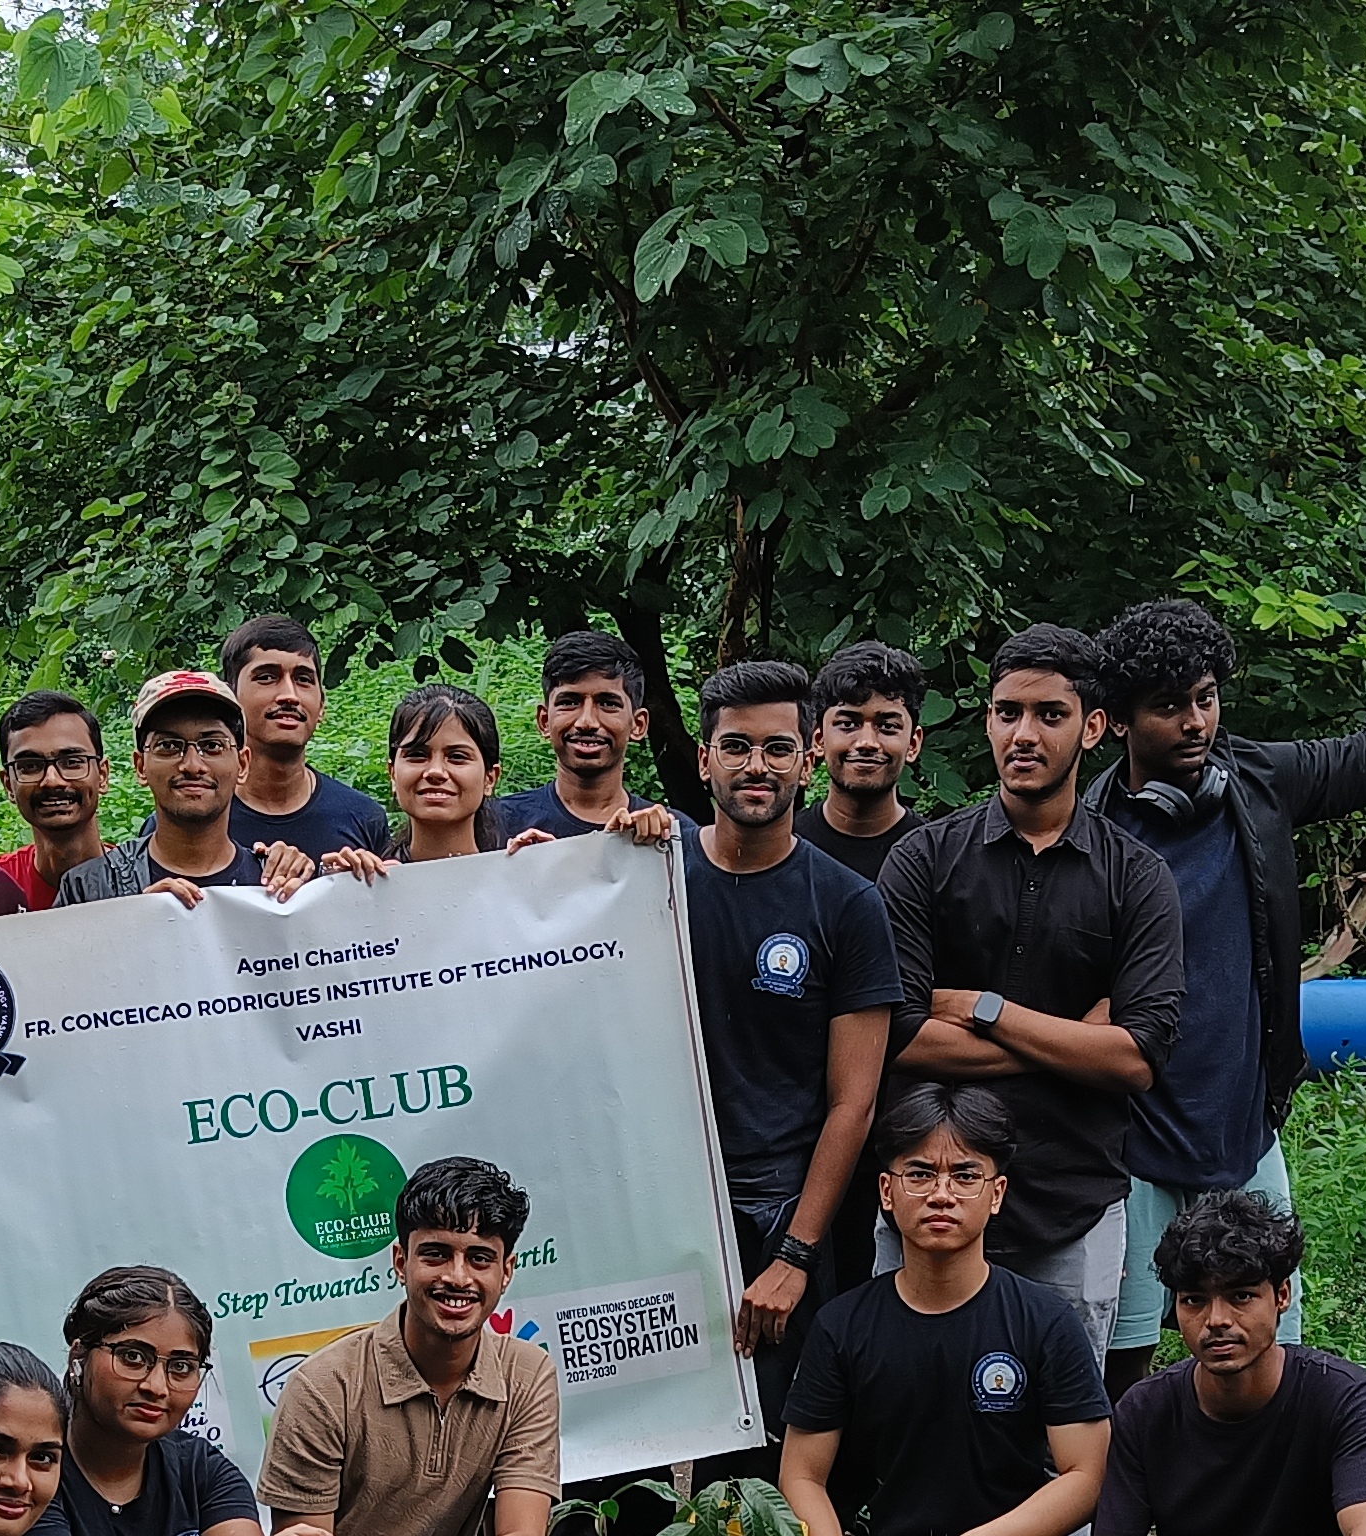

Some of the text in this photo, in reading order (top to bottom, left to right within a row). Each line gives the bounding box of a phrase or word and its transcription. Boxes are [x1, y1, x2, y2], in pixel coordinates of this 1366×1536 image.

[236, 952, 300, 976] Agnel
[25, 940, 625, 1038] FR. CONCEICAO RODRIGUES INSTITUTE OF TECHNOLOGY,
[296, 1018, 362, 1042] VASHI
[183, 1064, 473, 1145] ECO-CLUB
[315, 1212, 391, 1235] ECO-CLUB
[213, 1291, 269, 1320] Step
[275, 1266, 381, 1307] Towards
[556, 1292, 675, 1322] UNITED NATIONS DECADE ON
[558, 1304, 678, 1345] ECOSYSTEM
[562, 1324, 700, 1369] RESTORATION
[567, 1364, 618, 1384] 2021-2030
